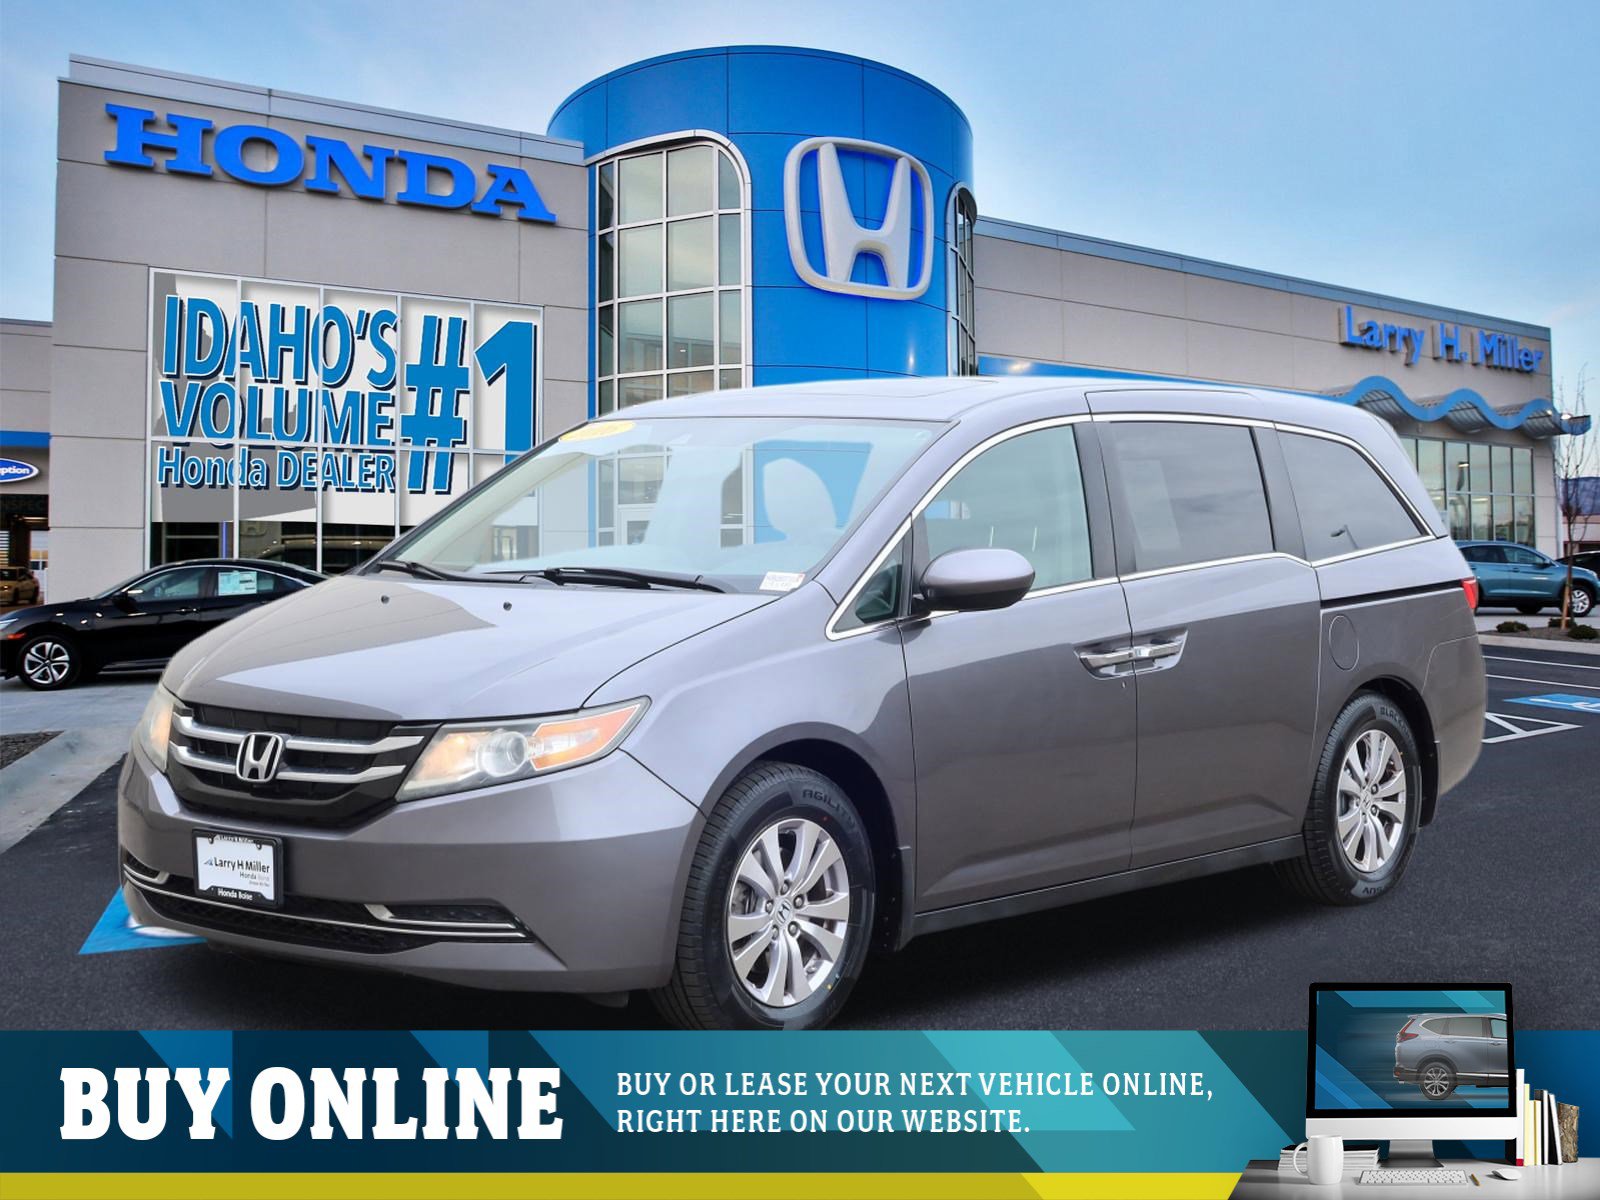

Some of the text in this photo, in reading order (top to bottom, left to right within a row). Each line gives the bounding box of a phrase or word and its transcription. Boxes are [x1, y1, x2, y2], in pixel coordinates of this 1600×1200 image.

[104, 102, 558, 224] HONDA
[162, 295, 398, 388] IDAHO'S
[1342, 304, 1544, 373] Larry H. Miller
[159, 380, 396, 450] VOLUME
[157, 446, 396, 492] Honda DEALER
[214, 857, 270, 873] Larry H Miller
[217, 887, 238, 899] Honda
